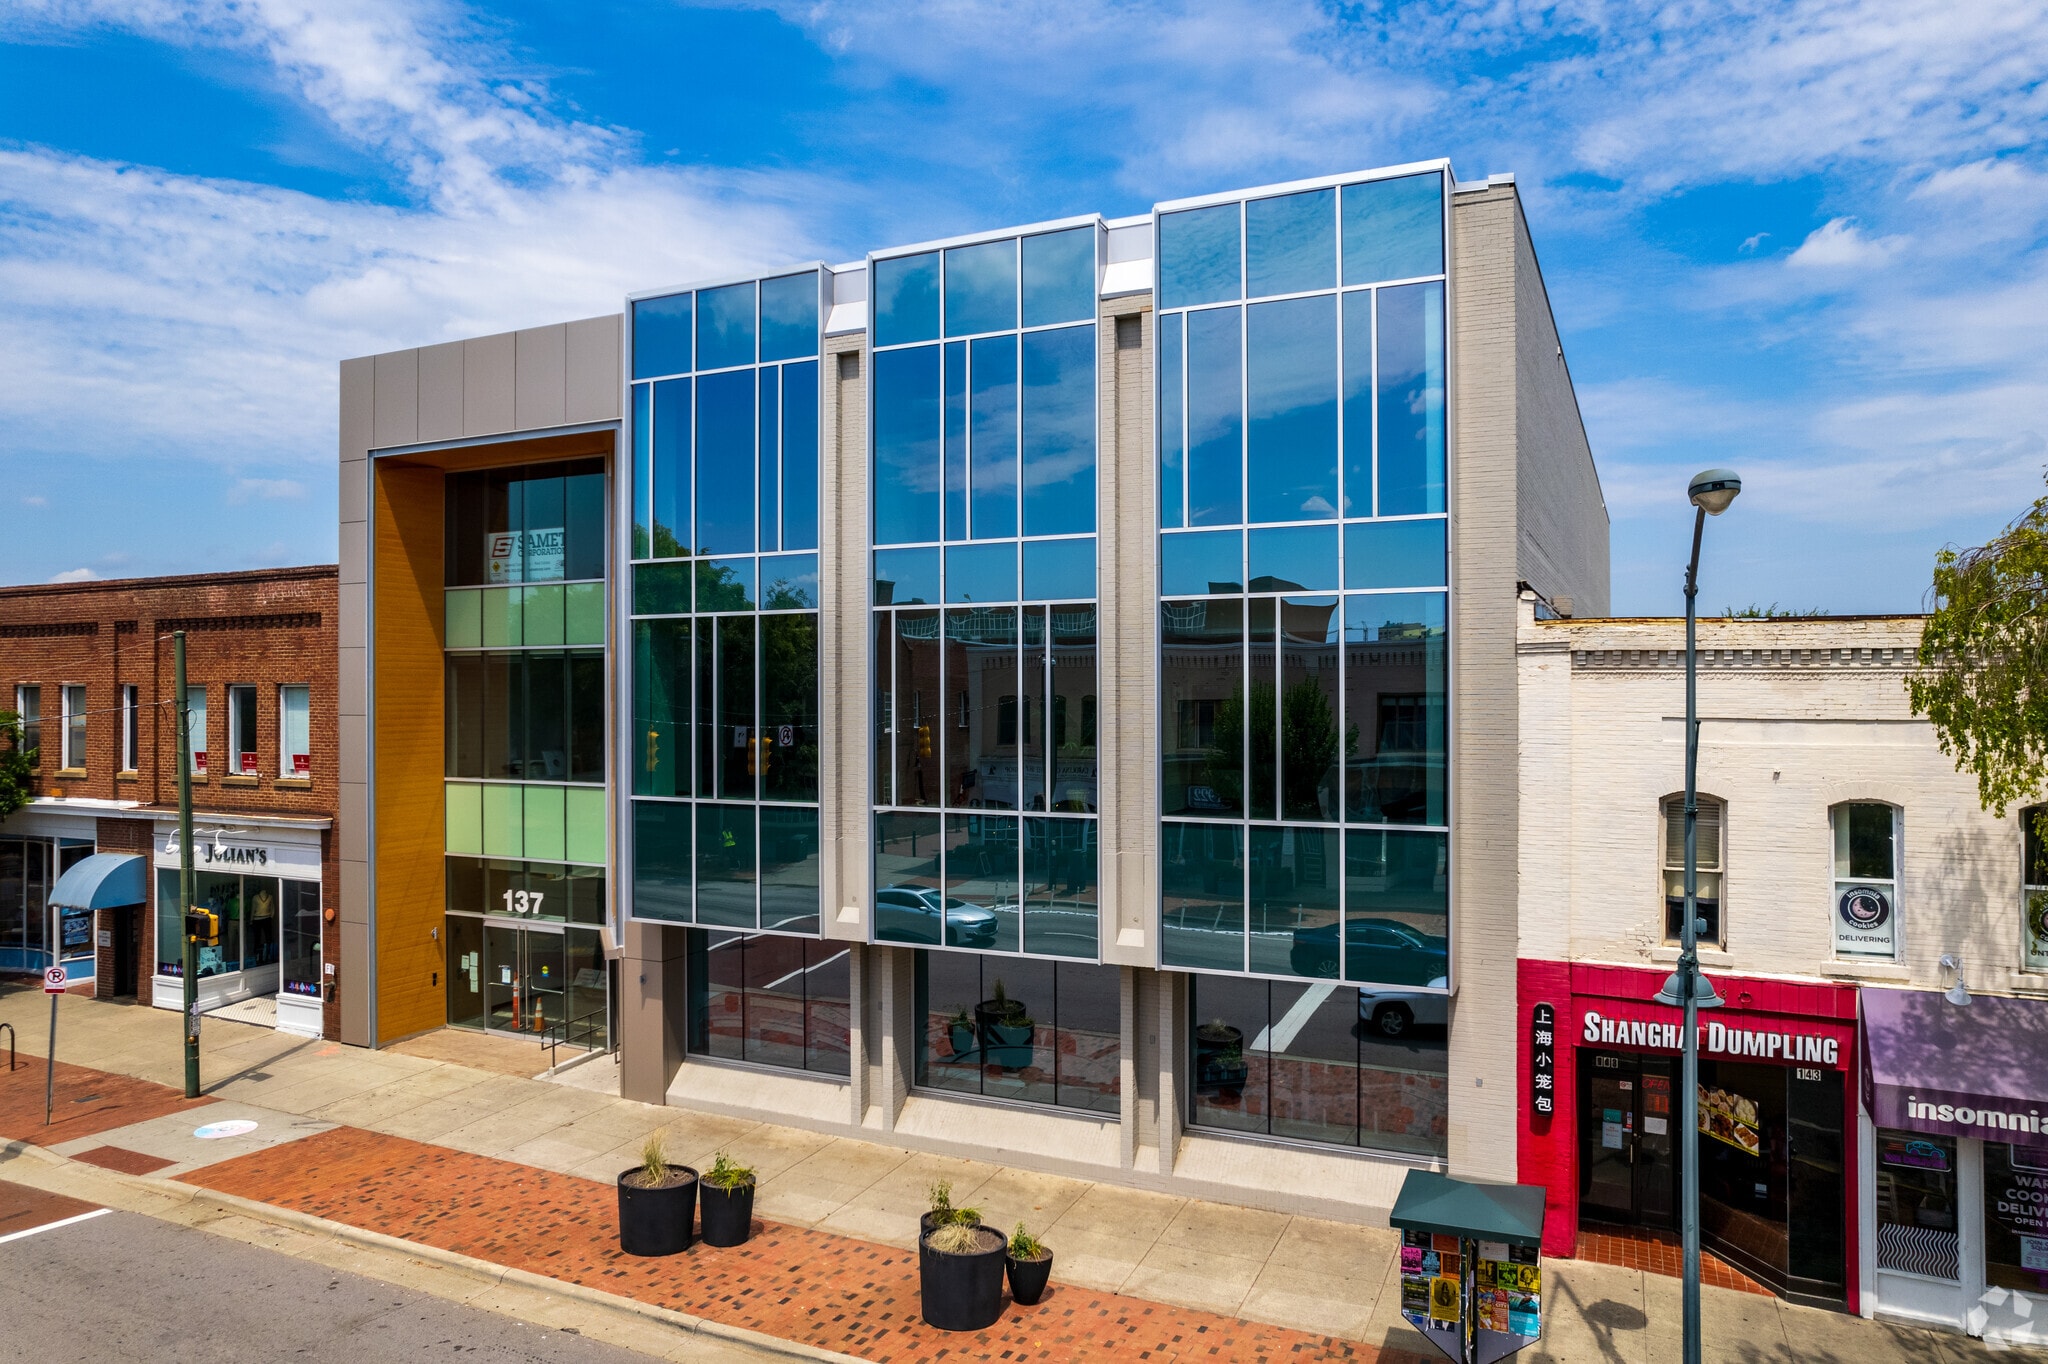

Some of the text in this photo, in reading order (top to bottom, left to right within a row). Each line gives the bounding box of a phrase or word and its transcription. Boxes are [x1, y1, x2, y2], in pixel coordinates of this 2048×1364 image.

[1846, 889, 1881, 900] insomnia
[503, 889, 544, 914] 137
[1848, 920, 1879, 929] cookies
[1838, 934, 1890, 944] DELIVERING
[1708, 1022, 1838, 1064] DUMPLING
[1535, 1009, 1552, 1112] 上海小笼包
[1797, 1068, 1821, 1081] 143
[2014, 1217, 2043, 1227] OPEN
